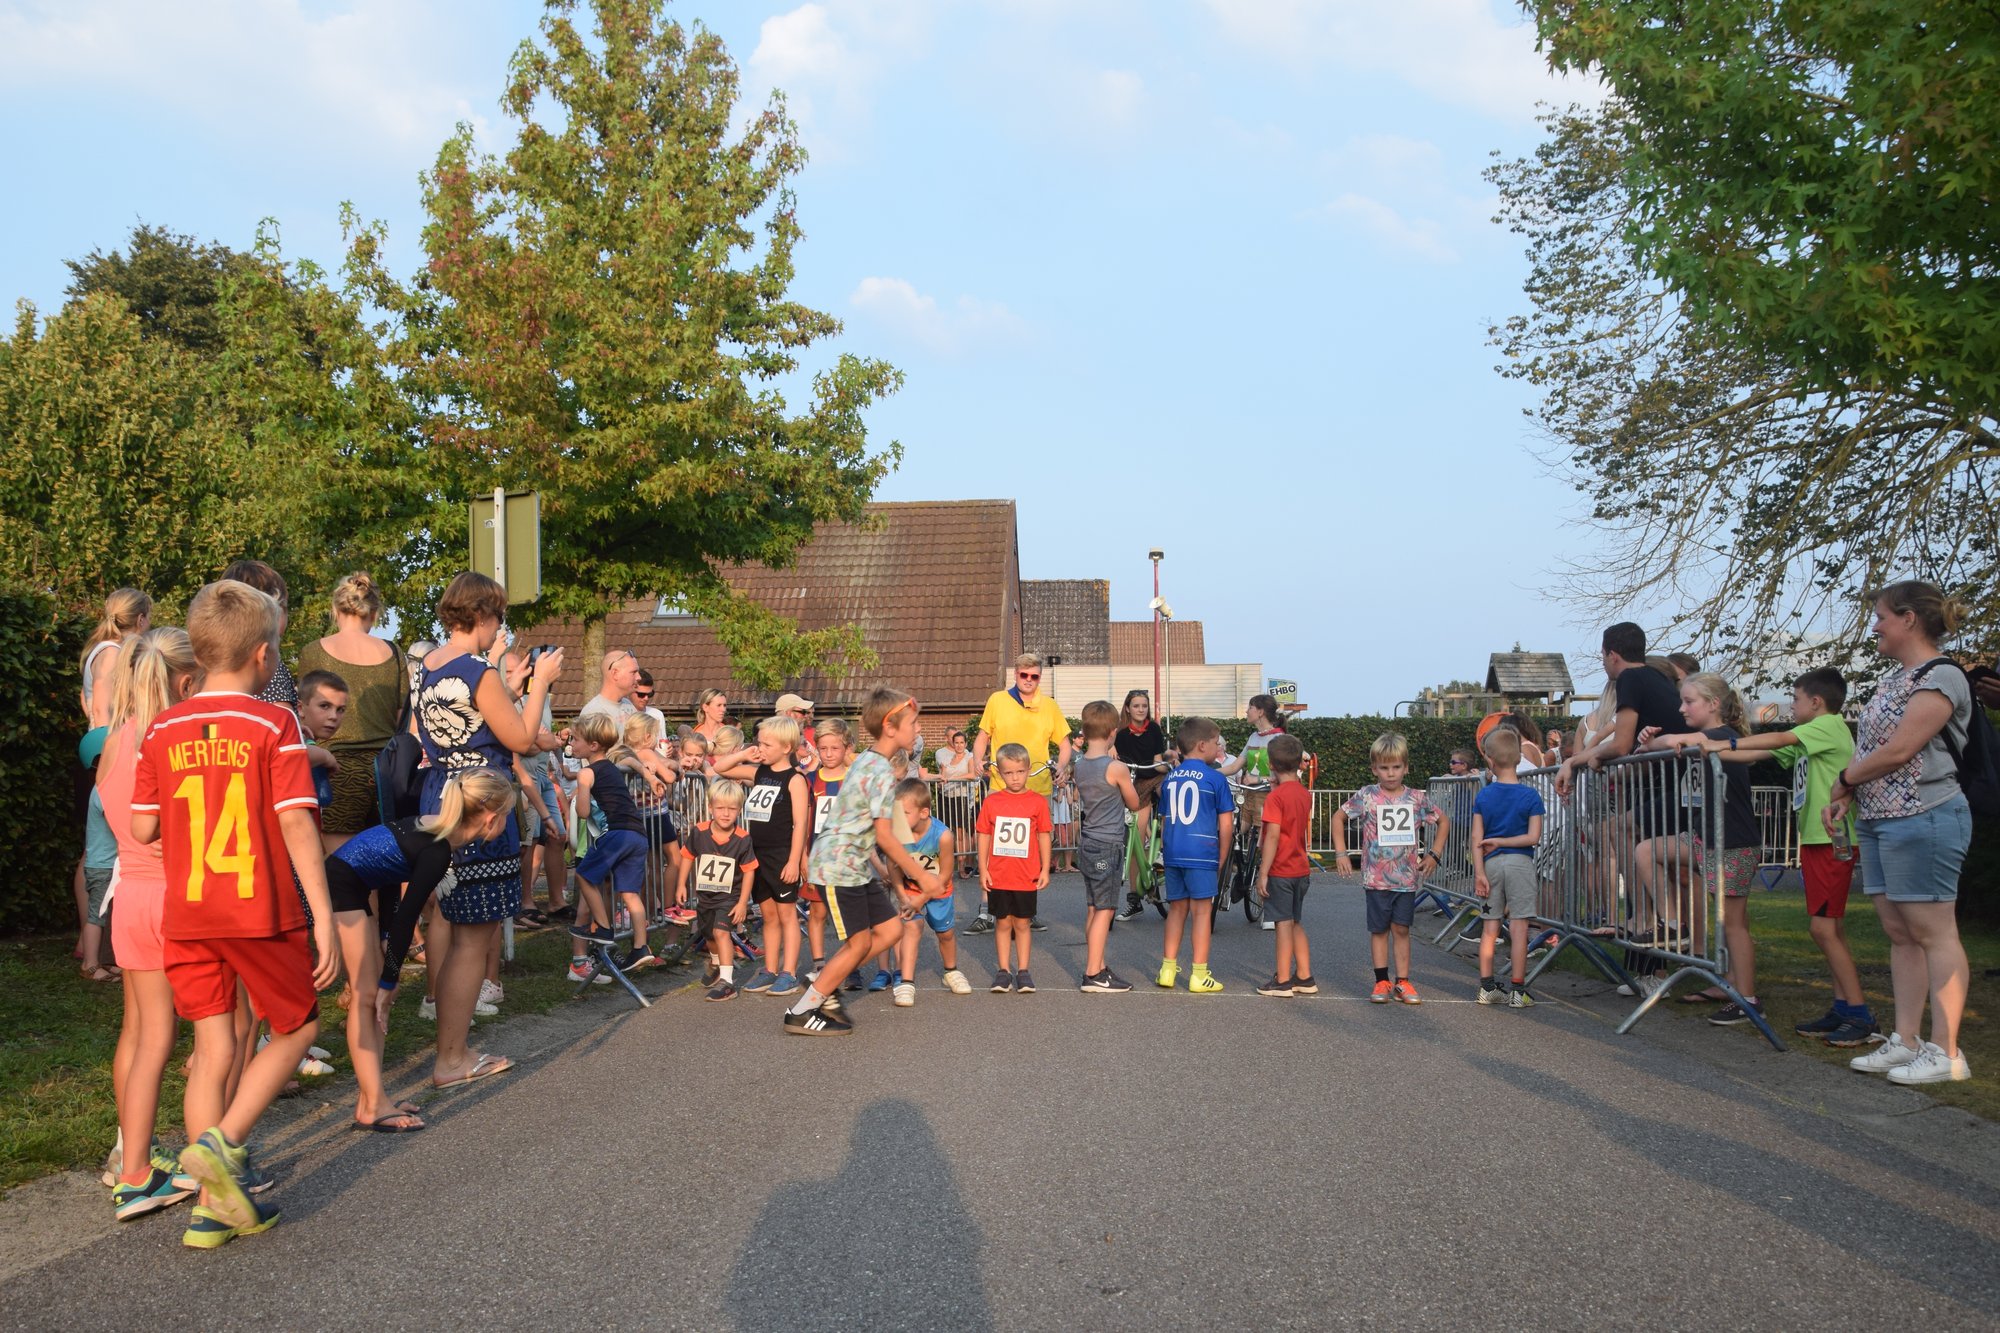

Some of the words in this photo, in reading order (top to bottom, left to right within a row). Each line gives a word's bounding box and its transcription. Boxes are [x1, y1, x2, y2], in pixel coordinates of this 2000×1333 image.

[1269, 685, 1296, 697] EHBO
[168, 738, 252, 772] MERTENS
[1168, 769, 1204, 781] HAZARD
[749, 789, 775, 809] 46
[1167, 780, 1200, 825] 10
[1382, 808, 1411, 832] 52
[173, 773, 256, 901] 14
[999, 822, 1027, 844] 50
[701, 859, 732, 883] 47
